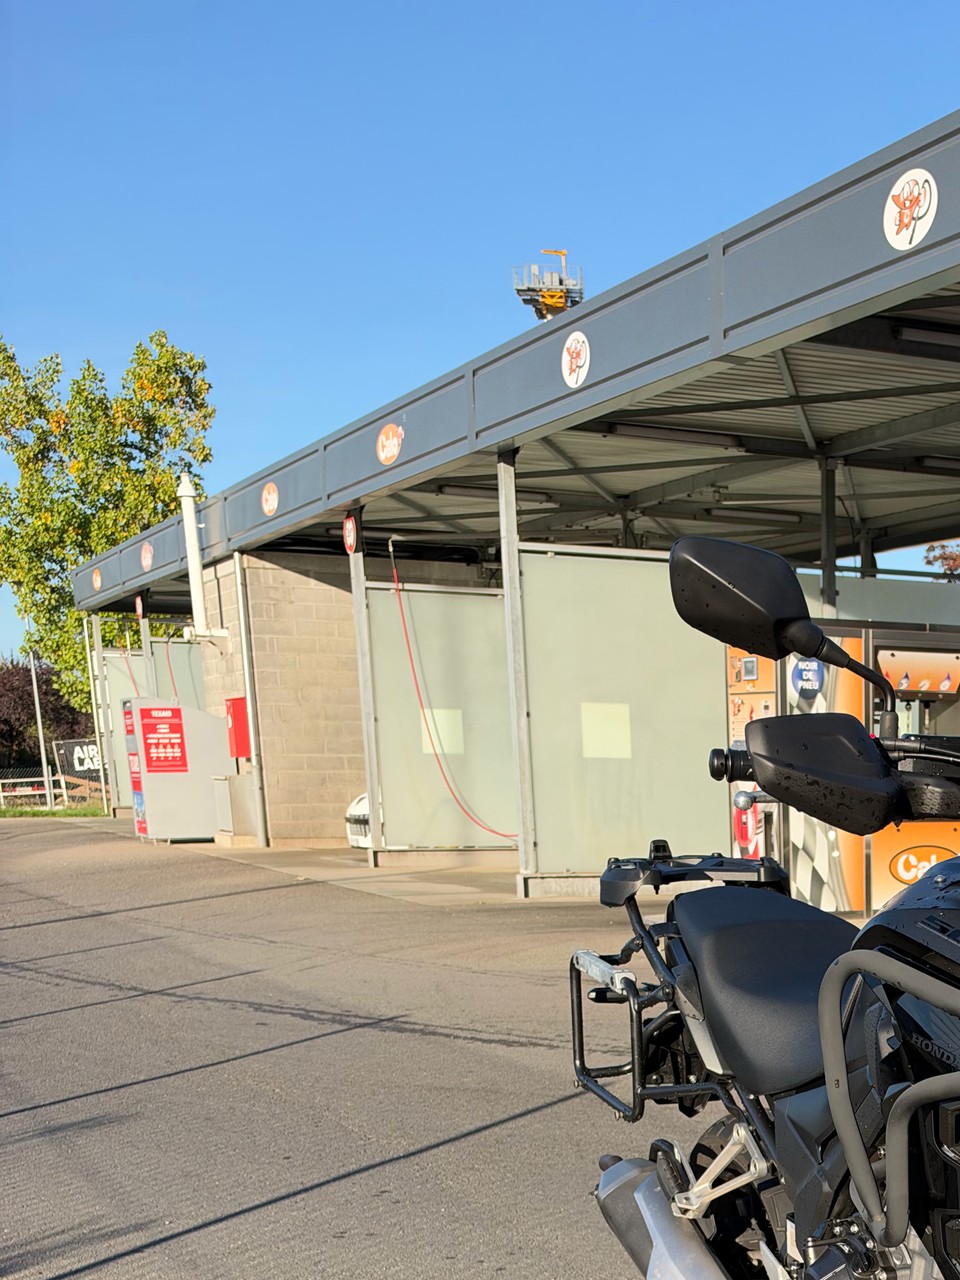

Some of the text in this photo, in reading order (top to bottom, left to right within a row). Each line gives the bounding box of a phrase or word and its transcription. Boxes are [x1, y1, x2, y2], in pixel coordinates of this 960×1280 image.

[378, 432, 399, 461] Calo
[798, 661, 818, 671] NOIR
[802, 671, 814, 680] DE
[798, 680, 819, 690] PNEU
[73, 745, 98, 759] AIR
[897, 854, 937, 881] Ca
